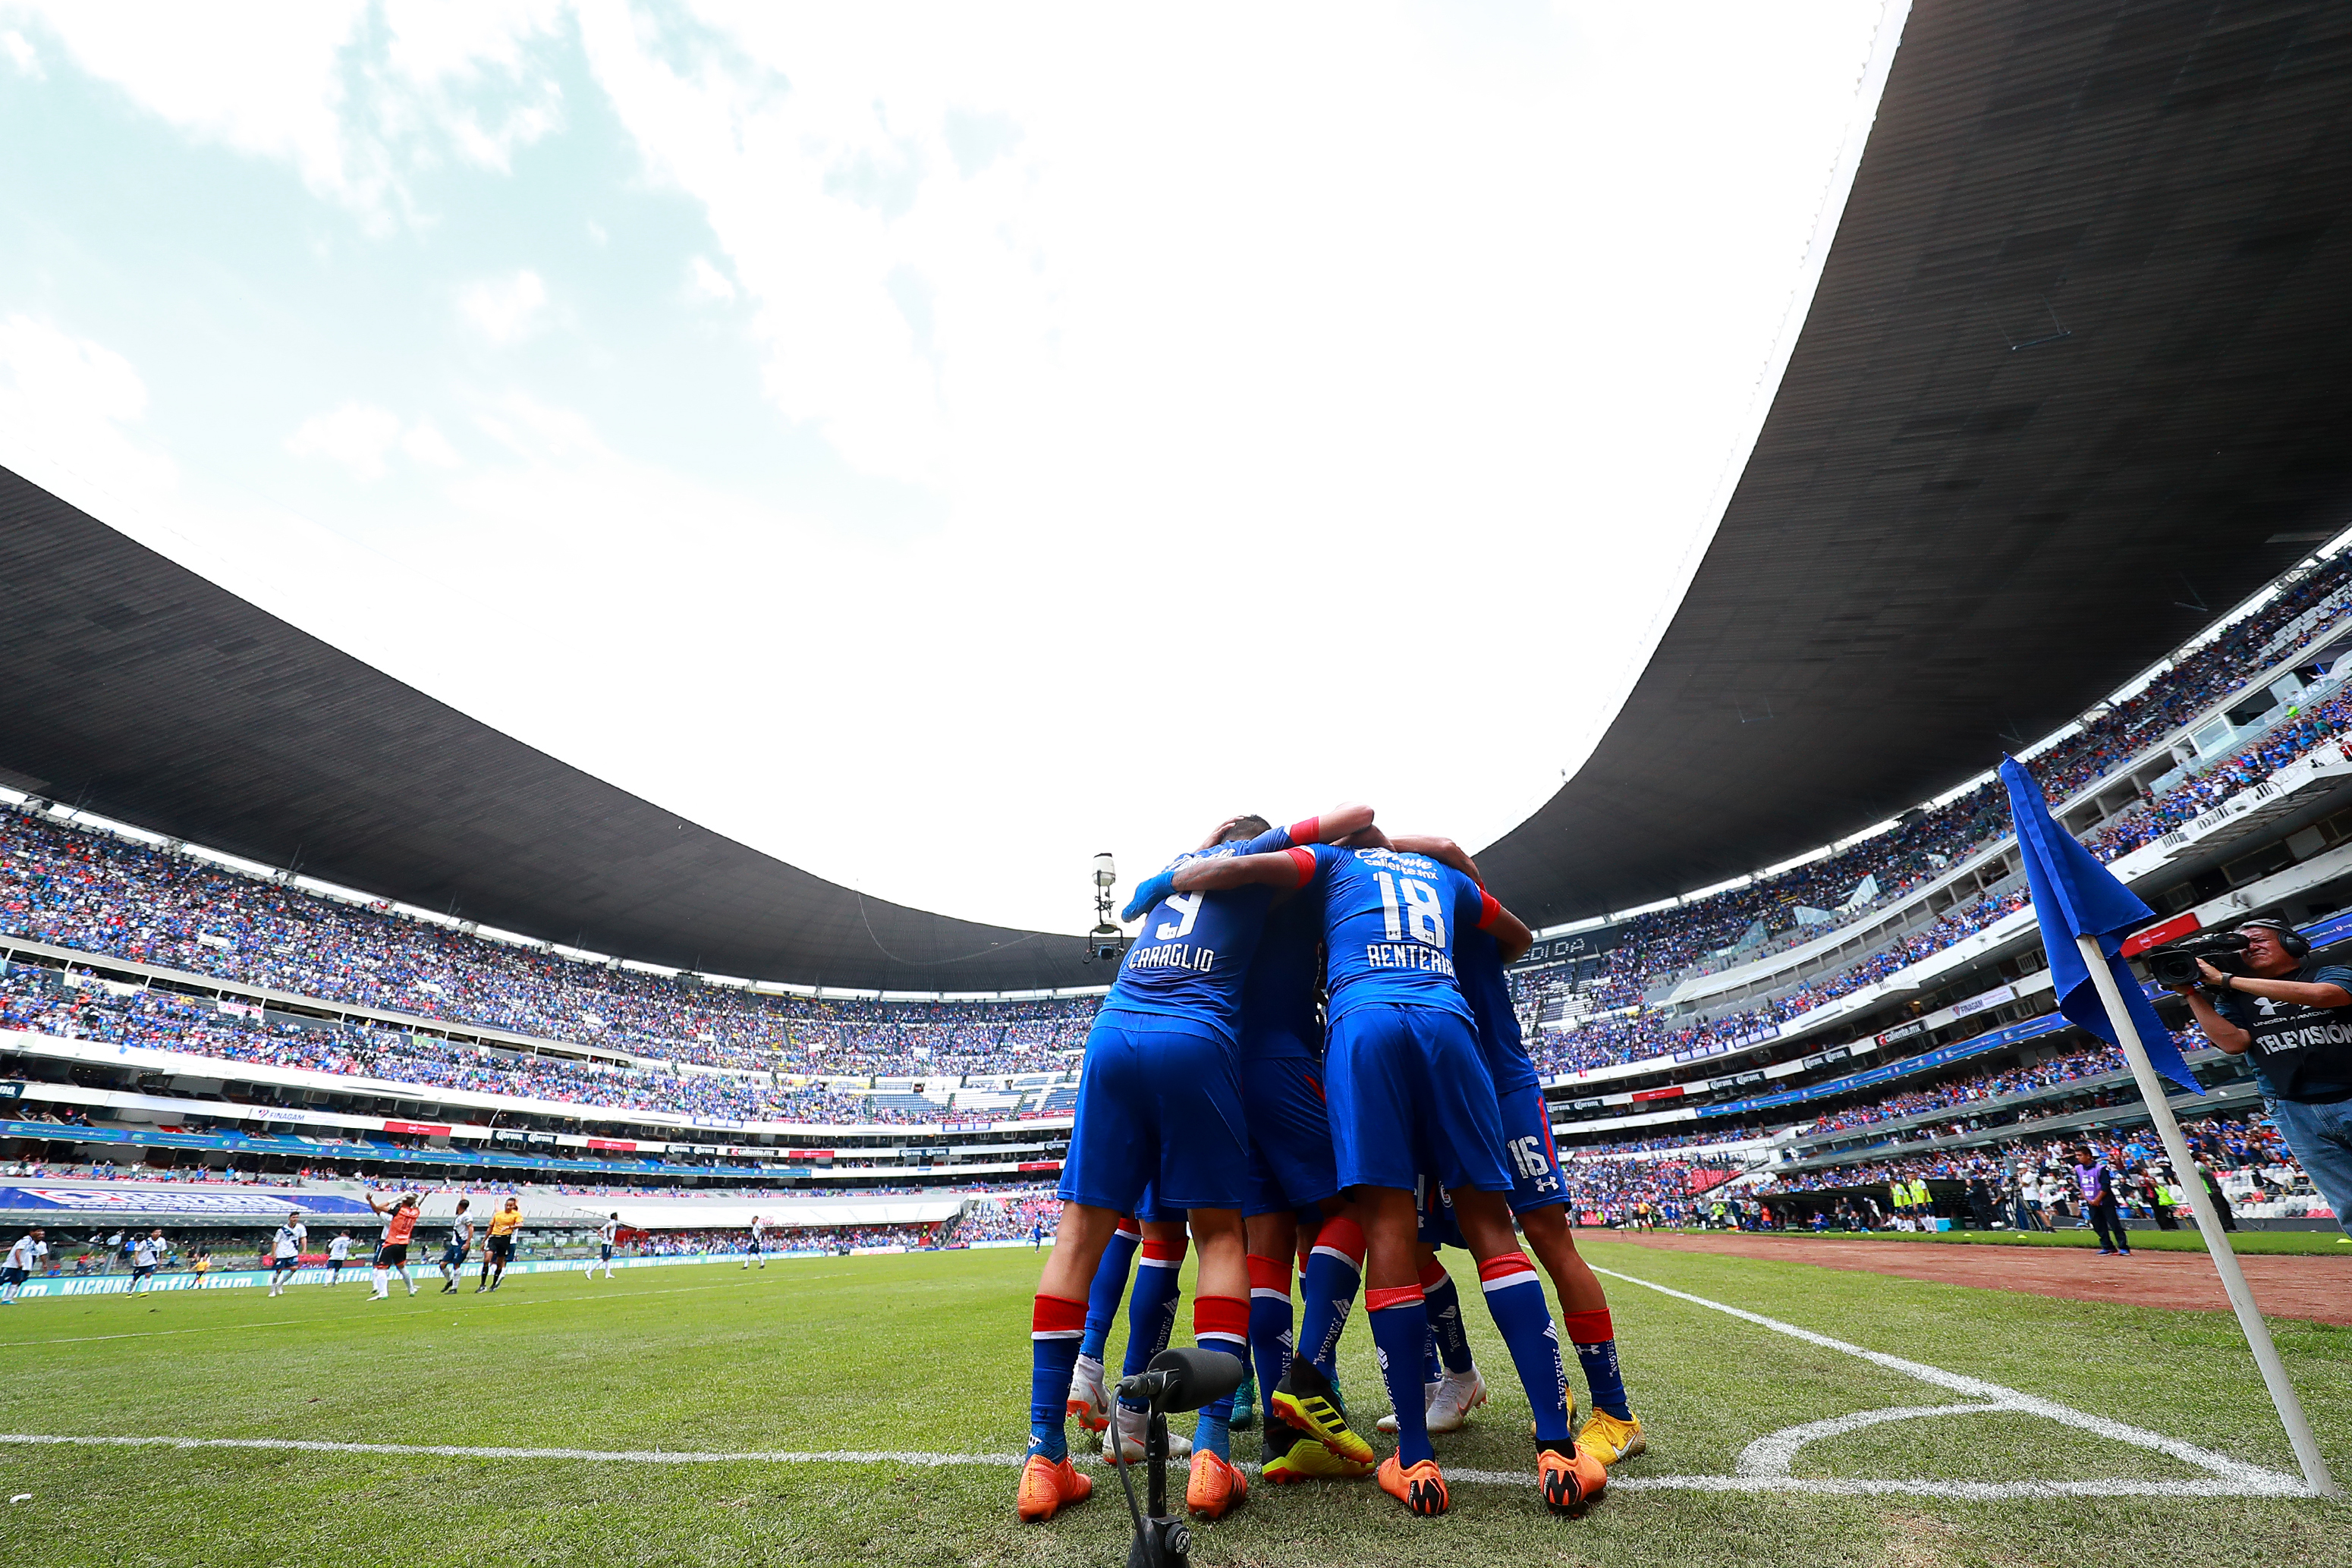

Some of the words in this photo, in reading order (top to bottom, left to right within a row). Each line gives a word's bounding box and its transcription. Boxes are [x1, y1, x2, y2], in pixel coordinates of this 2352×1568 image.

[1155, 890, 1206, 941] 9
[1372, 871, 1446, 949] 18
[1128, 943, 1215, 973] CARAGLIO
[1366, 944, 1454, 978] RENTERIA
[1961, 999, 1984, 1013] FINAGAM
[2253, 1017, 2288, 1027] UNDER
[1885, 1023, 1922, 1043] caliente.mx
[2256, 1020, 2352, 1055] TELEVISIÓN
[1825, 1049, 1847, 1063] Corona
[1710, 1078, 1734, 1090] Corona
[1736, 1073, 1762, 1085] Corona
[1547, 1105, 1571, 1114] Corona
[1574, 1100, 1599, 1110] Corona
[269, 1112, 305, 1121] FINAGAM
[495, 1130, 524, 1142] Corona
[527, 1133, 554, 1144] Corona
[668, 1145, 690, 1155] Corona
[693, 1146, 715, 1155] Corona
[738, 1149, 775, 1157] caliente.mx
[1046, 1142, 1066, 1151] Corona
[1507, 1135, 1550, 1179] 16
[536, 1261, 571, 1272] MACRONET
[1317, 1317, 1342, 1362] FINAGAM
[1552, 1348, 1567, 1405] FINAGAM
